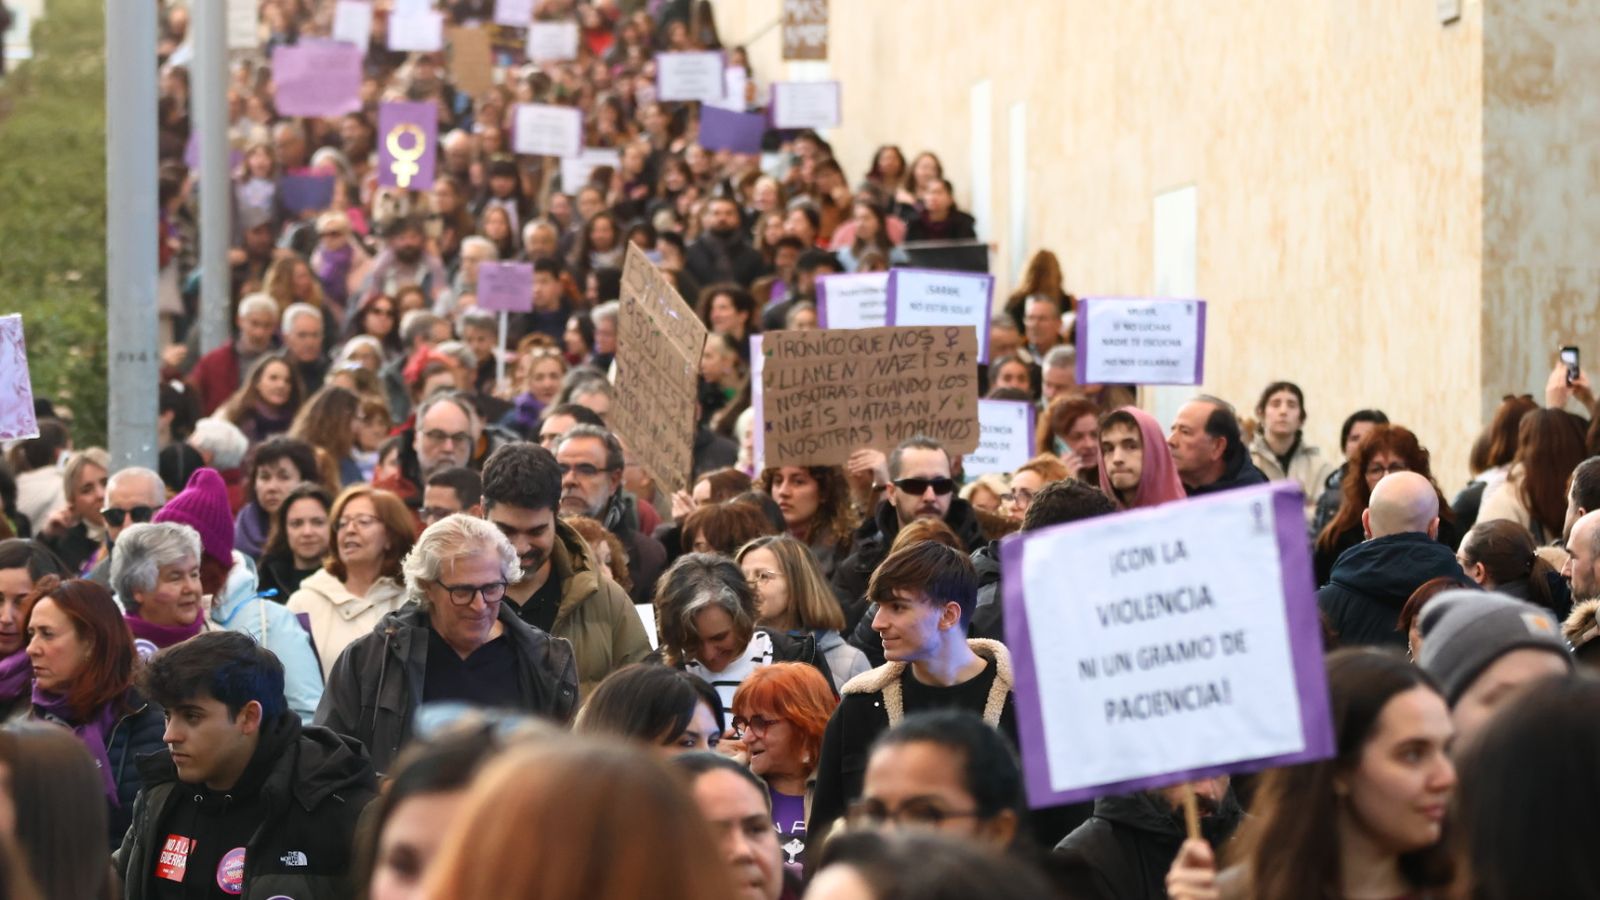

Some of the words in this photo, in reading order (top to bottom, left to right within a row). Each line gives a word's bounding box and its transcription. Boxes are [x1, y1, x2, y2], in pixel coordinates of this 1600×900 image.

[850, 334, 884, 355] QUE
[889, 329, 935, 350] NOS
[780, 361, 857, 390] LLAMEN
[956, 352, 969, 367] A
[777, 386, 857, 414] NOSOTRAS
[865, 377, 932, 398] CUANDO
[937, 374, 969, 391] LOS
[849, 400, 930, 421] MATABAN
[939, 395, 951, 412] Y
[778, 425, 873, 460] NOSOTRAS
[1110, 545, 1156, 576] ¡CON
[1161, 540, 1188, 564] LA
[1097, 584, 1214, 627] VIOLENCIA
[1078, 657, 1097, 681] NI
[1102, 652, 1132, 677] UN
[1136, 635, 1217, 671] GRAMO
[1220, 629, 1247, 656] DE
[1104, 677, 1232, 724] PACIENCIA!
[160, 850, 187, 869] GUERRA
[164, 838, 176, 851] NO
[174, 840, 181, 852] A
